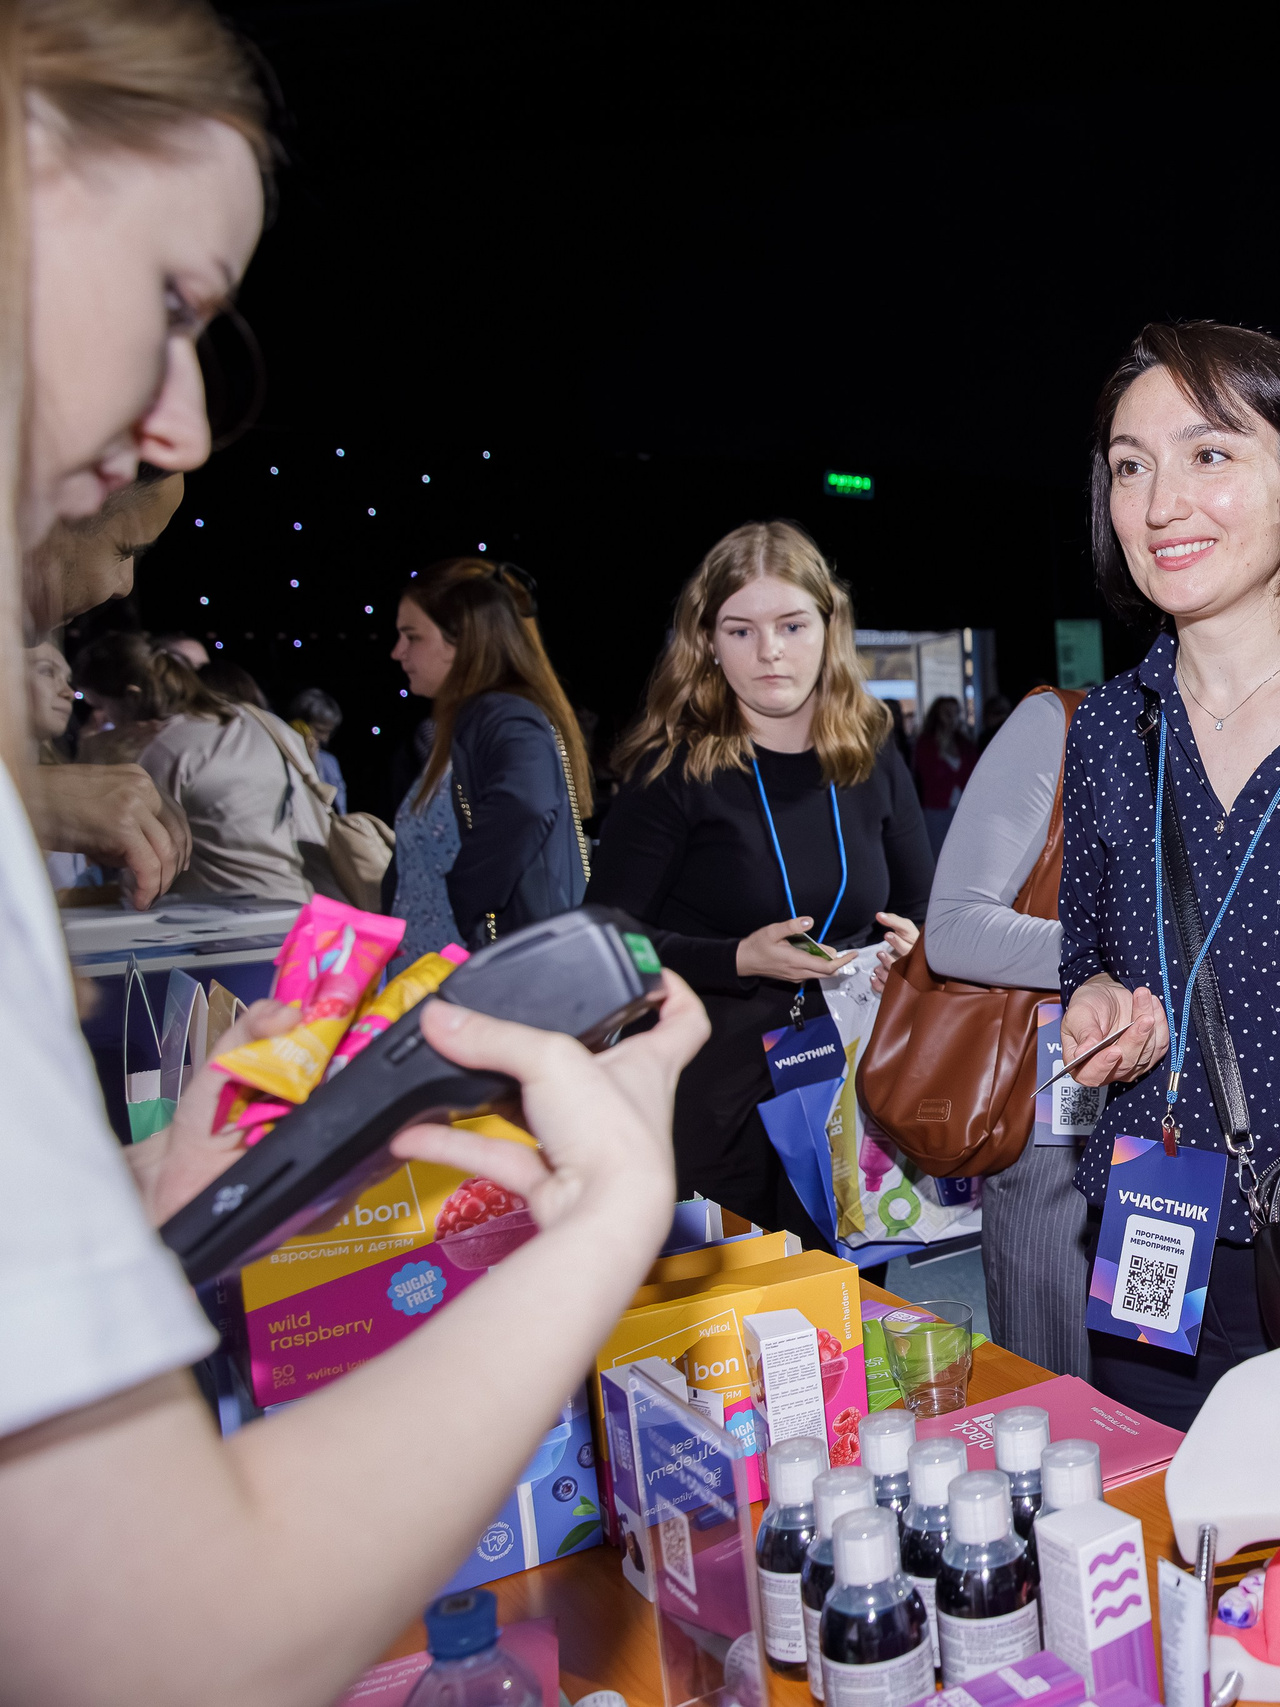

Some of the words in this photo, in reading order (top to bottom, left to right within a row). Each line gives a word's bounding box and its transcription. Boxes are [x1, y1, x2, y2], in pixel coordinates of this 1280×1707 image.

[775, 1043, 836, 1070] УЧАСТНИК
[1118, 1189, 1209, 1222] УЧАСТНИК
[1130, 1237, 1186, 1256] МЕРОПРИЯТИЯ
[1135, 1229, 1182, 1246] ПРОГРАММА
[270, 1245, 350, 1265] взрослым
[354, 1243, 364, 1253] и
[368, 1237, 415, 1253] детям
[393, 1269, 437, 1299] SUGAR
[405, 1284, 437, 1309] FREE
[268, 1310, 312, 1335] wild
[699, 1321, 731, 1338] xylitol
[842, 1321, 852, 1340] erin
[270, 1318, 374, 1352] raspberry
[272, 1364, 295, 1380] 50
[274, 1376, 297, 1390] pcs
[306, 1364, 344, 1380] xylitol
[731, 1418, 755, 1440] UGA
